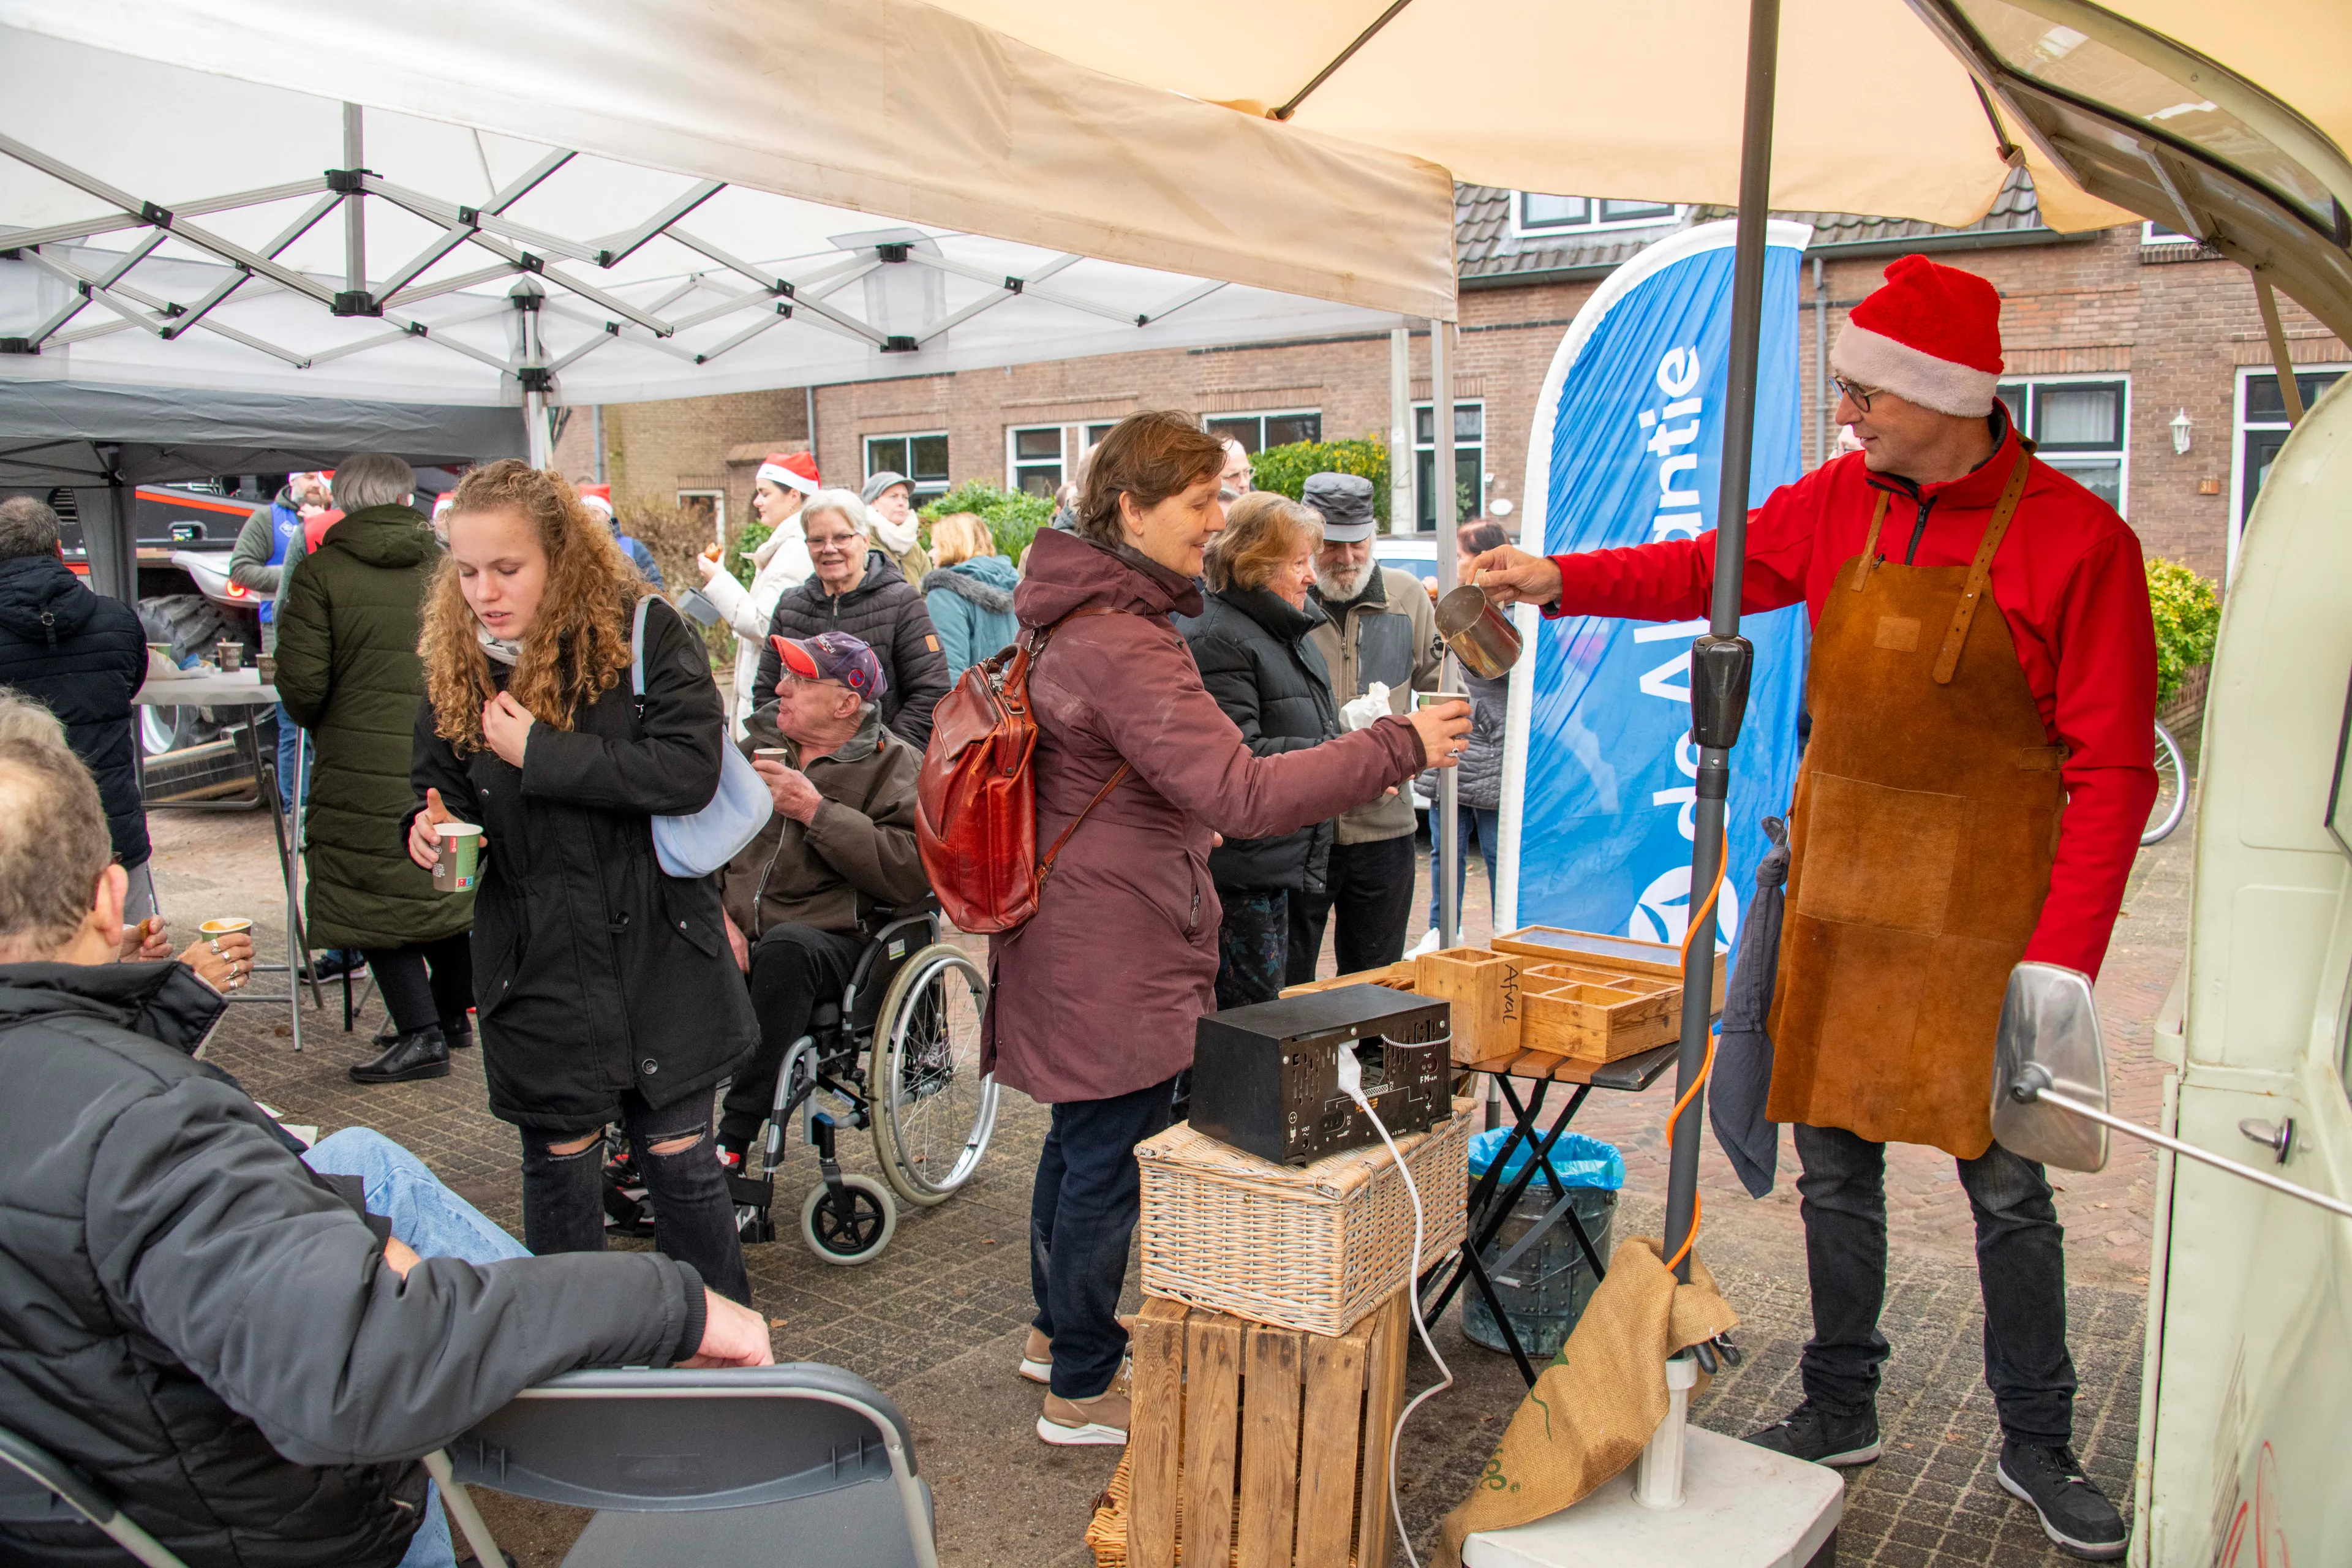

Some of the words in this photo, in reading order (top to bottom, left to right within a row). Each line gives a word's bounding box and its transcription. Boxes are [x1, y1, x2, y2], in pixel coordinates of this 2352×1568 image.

[2201, 480, 2211, 491] 31
[1633, 344, 1711, 705] Alantie
[1500, 963, 1519, 1025] Afval
